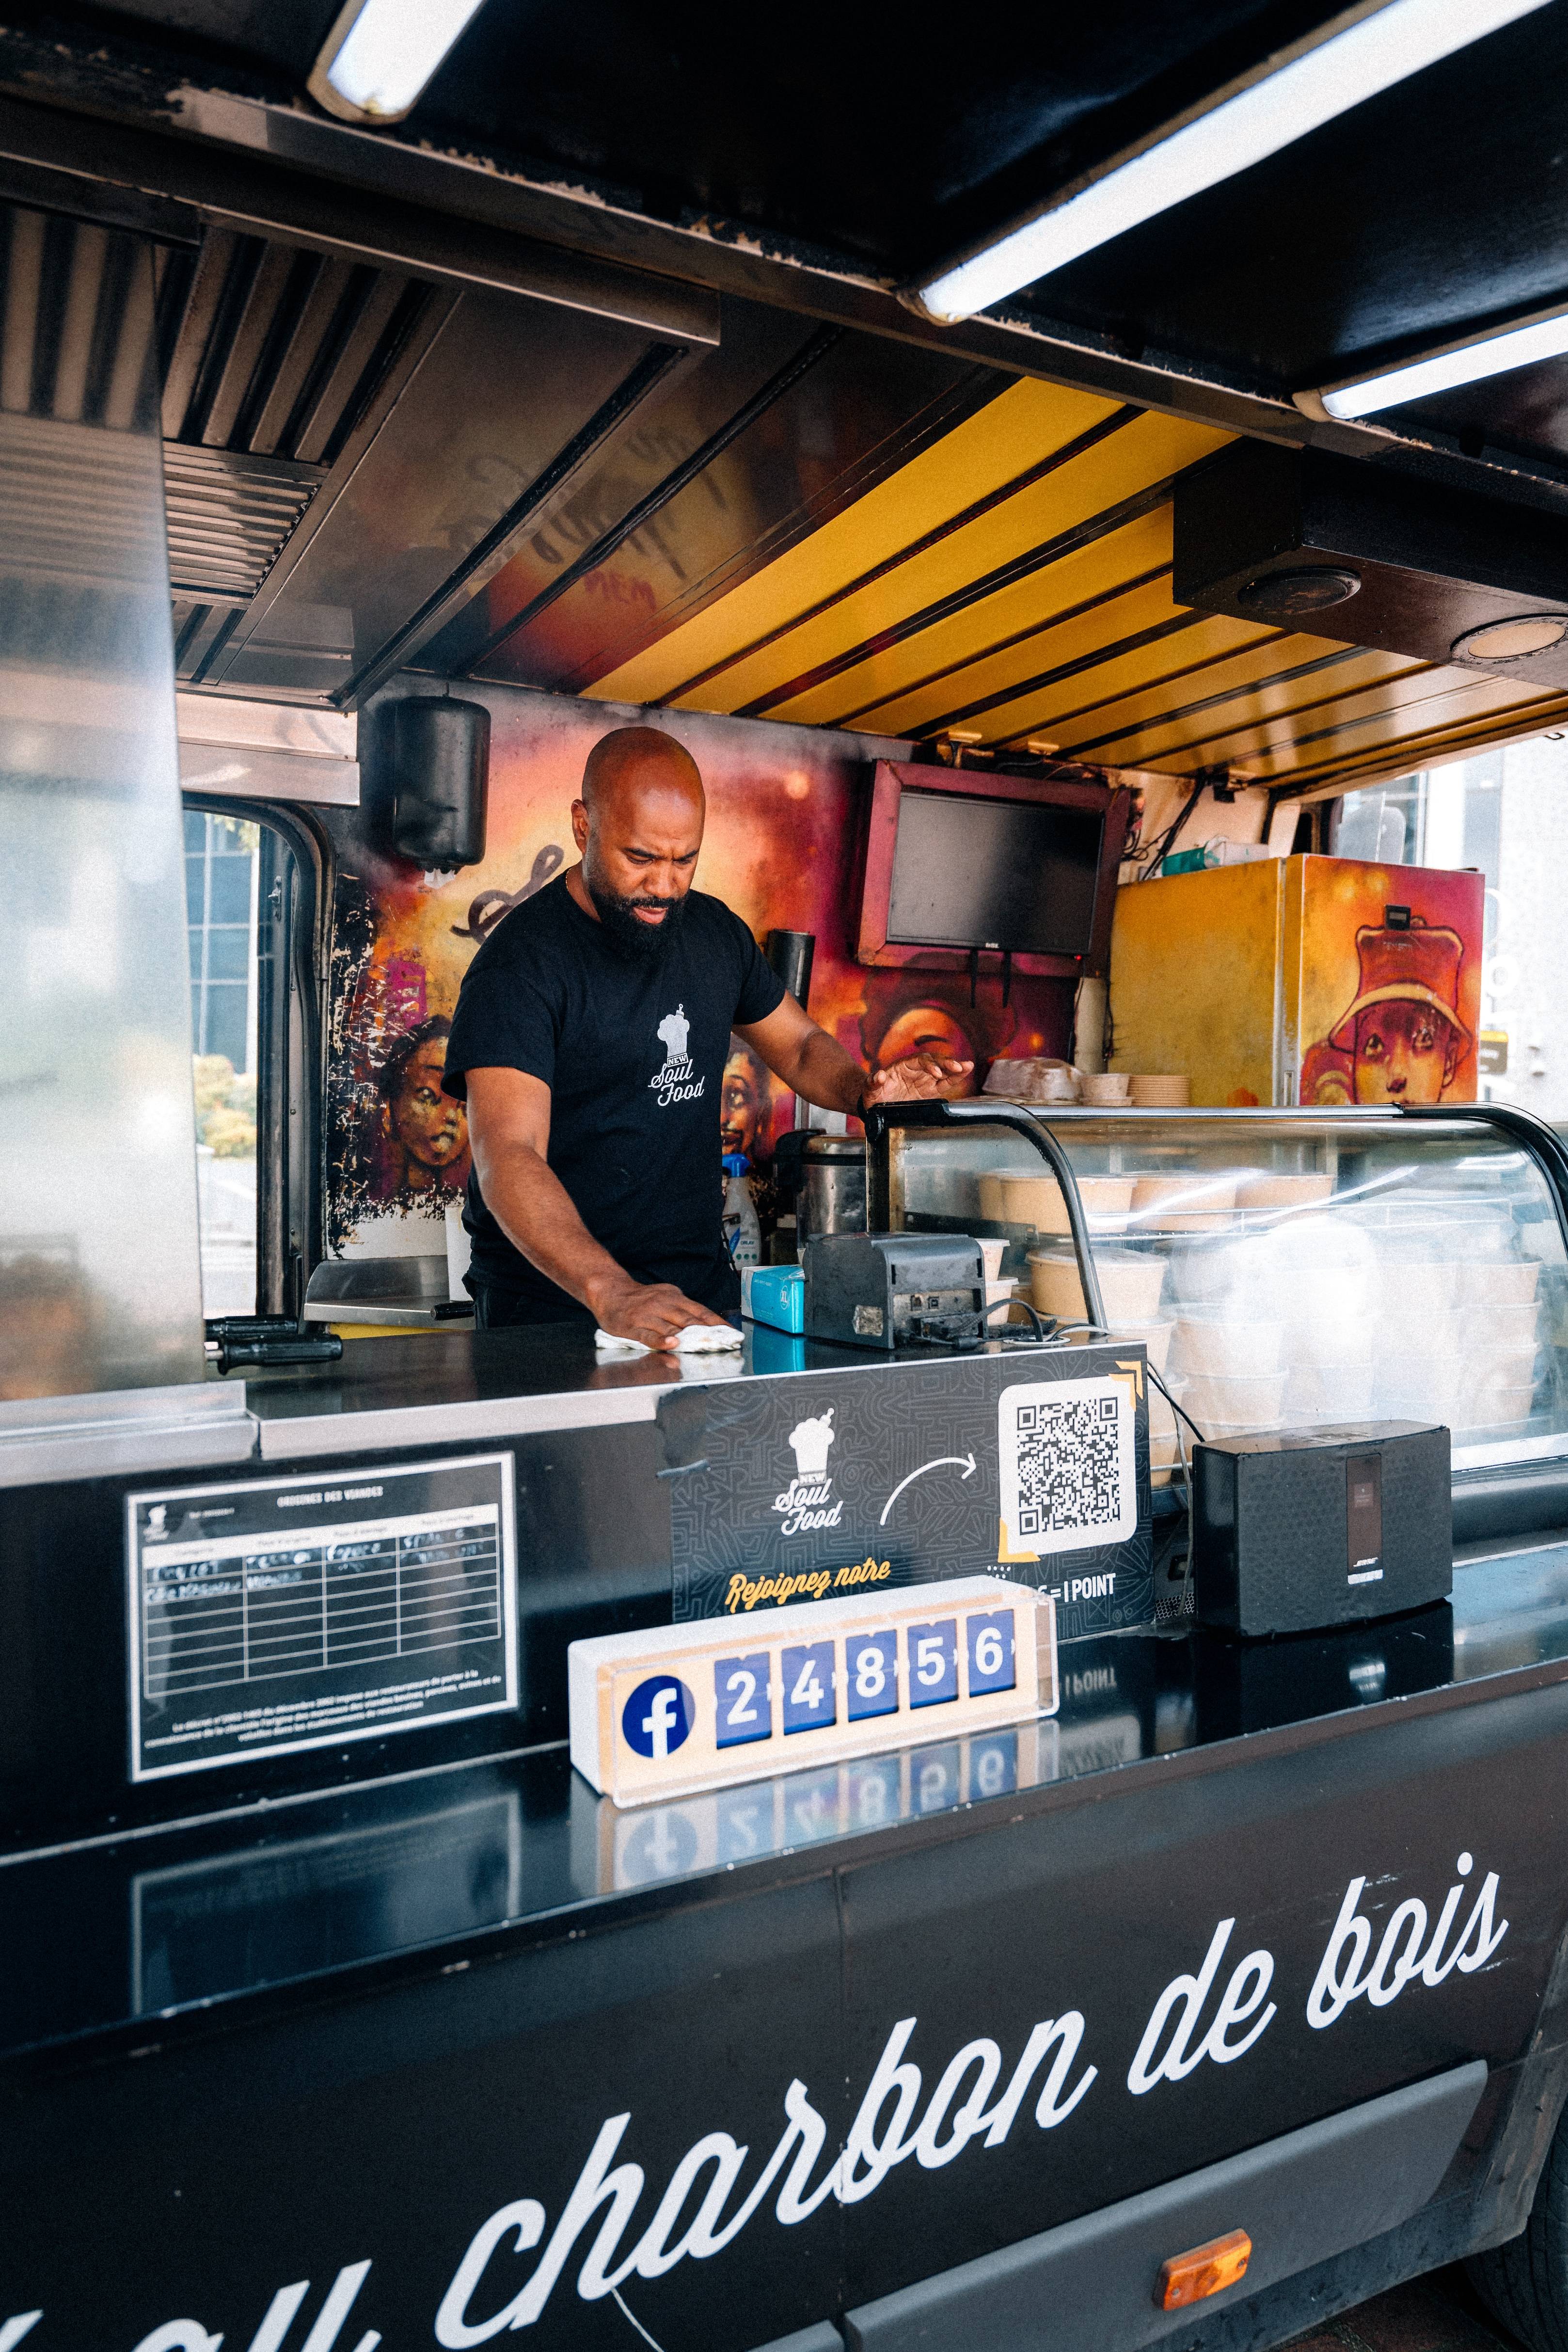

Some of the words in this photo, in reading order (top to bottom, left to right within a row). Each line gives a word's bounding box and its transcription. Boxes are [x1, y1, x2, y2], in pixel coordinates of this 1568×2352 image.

[648, 1059, 693, 1089] Soul
[668, 1054, 687, 1065] NEW
[657, 1076, 705, 1107] Food
[799, 1472, 826, 1484] NEW
[771, 1478, 833, 1512] Soul
[781, 1500, 844, 1536] Food
[725, 1571, 832, 1614] Rejoignez
[833, 1557, 892, 1588] notre
[1072, 1573, 1116, 1602] POINT
[436, 2011, 1097, 2351] charbon
[1128, 1918, 1277, 2095] de
[1306, 1852, 1509, 2029] bois
